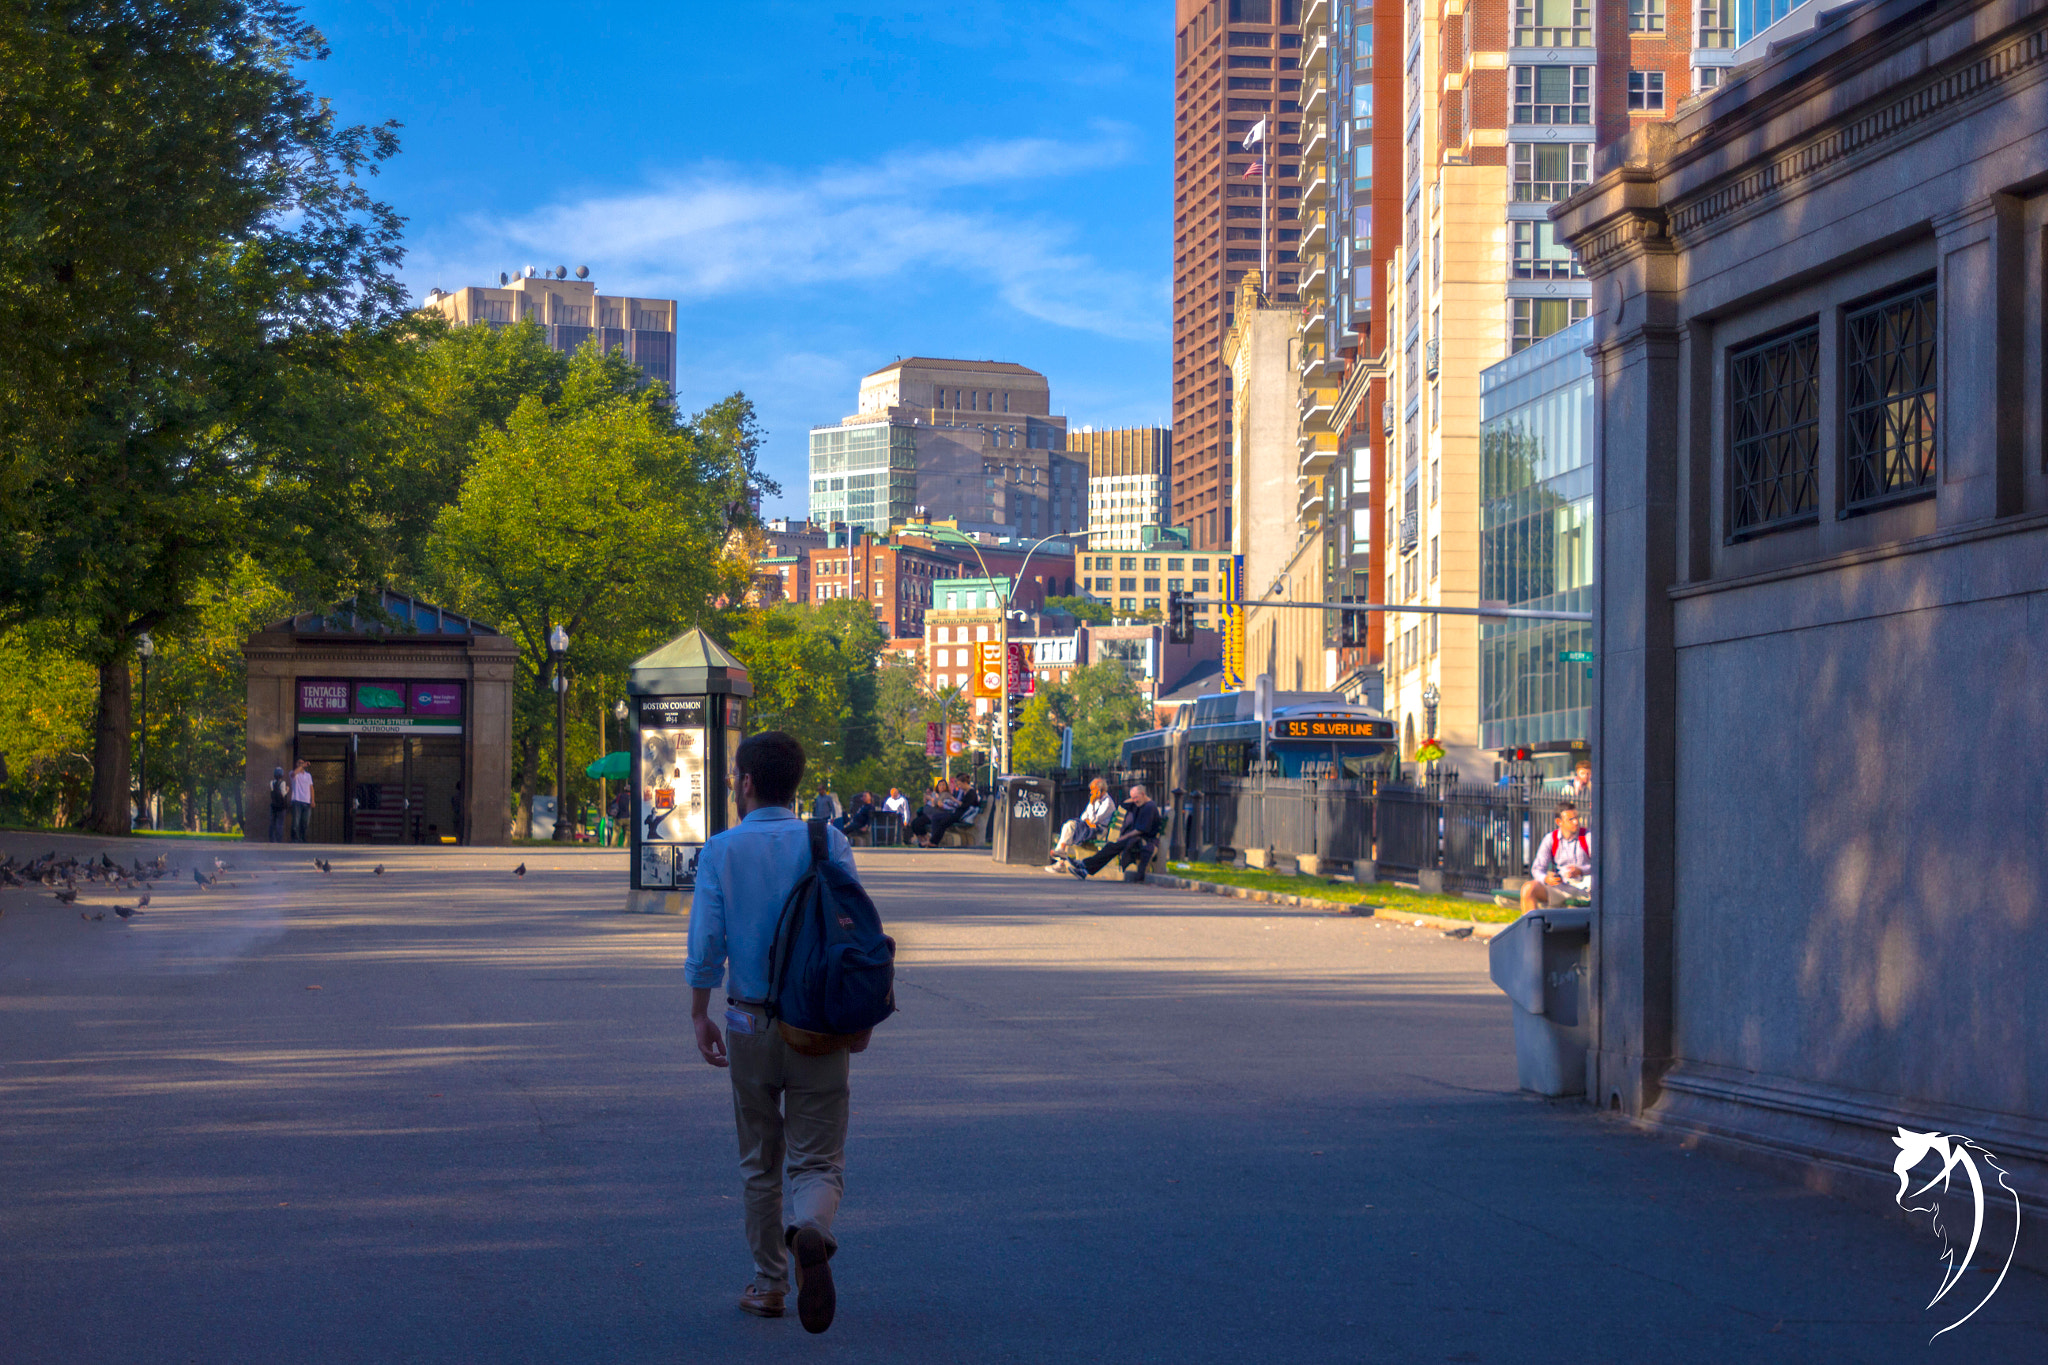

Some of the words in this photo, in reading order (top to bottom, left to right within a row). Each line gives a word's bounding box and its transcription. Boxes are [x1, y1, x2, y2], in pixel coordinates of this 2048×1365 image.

[303, 686, 347, 698] TENTACLES
[304, 698, 323, 708] TAKE
[326, 698, 347, 709] HOLD
[643, 702, 669, 710] BOSTON
[670, 701, 701, 710] COMMON
[1289, 721, 1308, 736] SL5
[1312, 723, 1348, 735] SILVER
[1350, 723, 1373, 736] LINE
